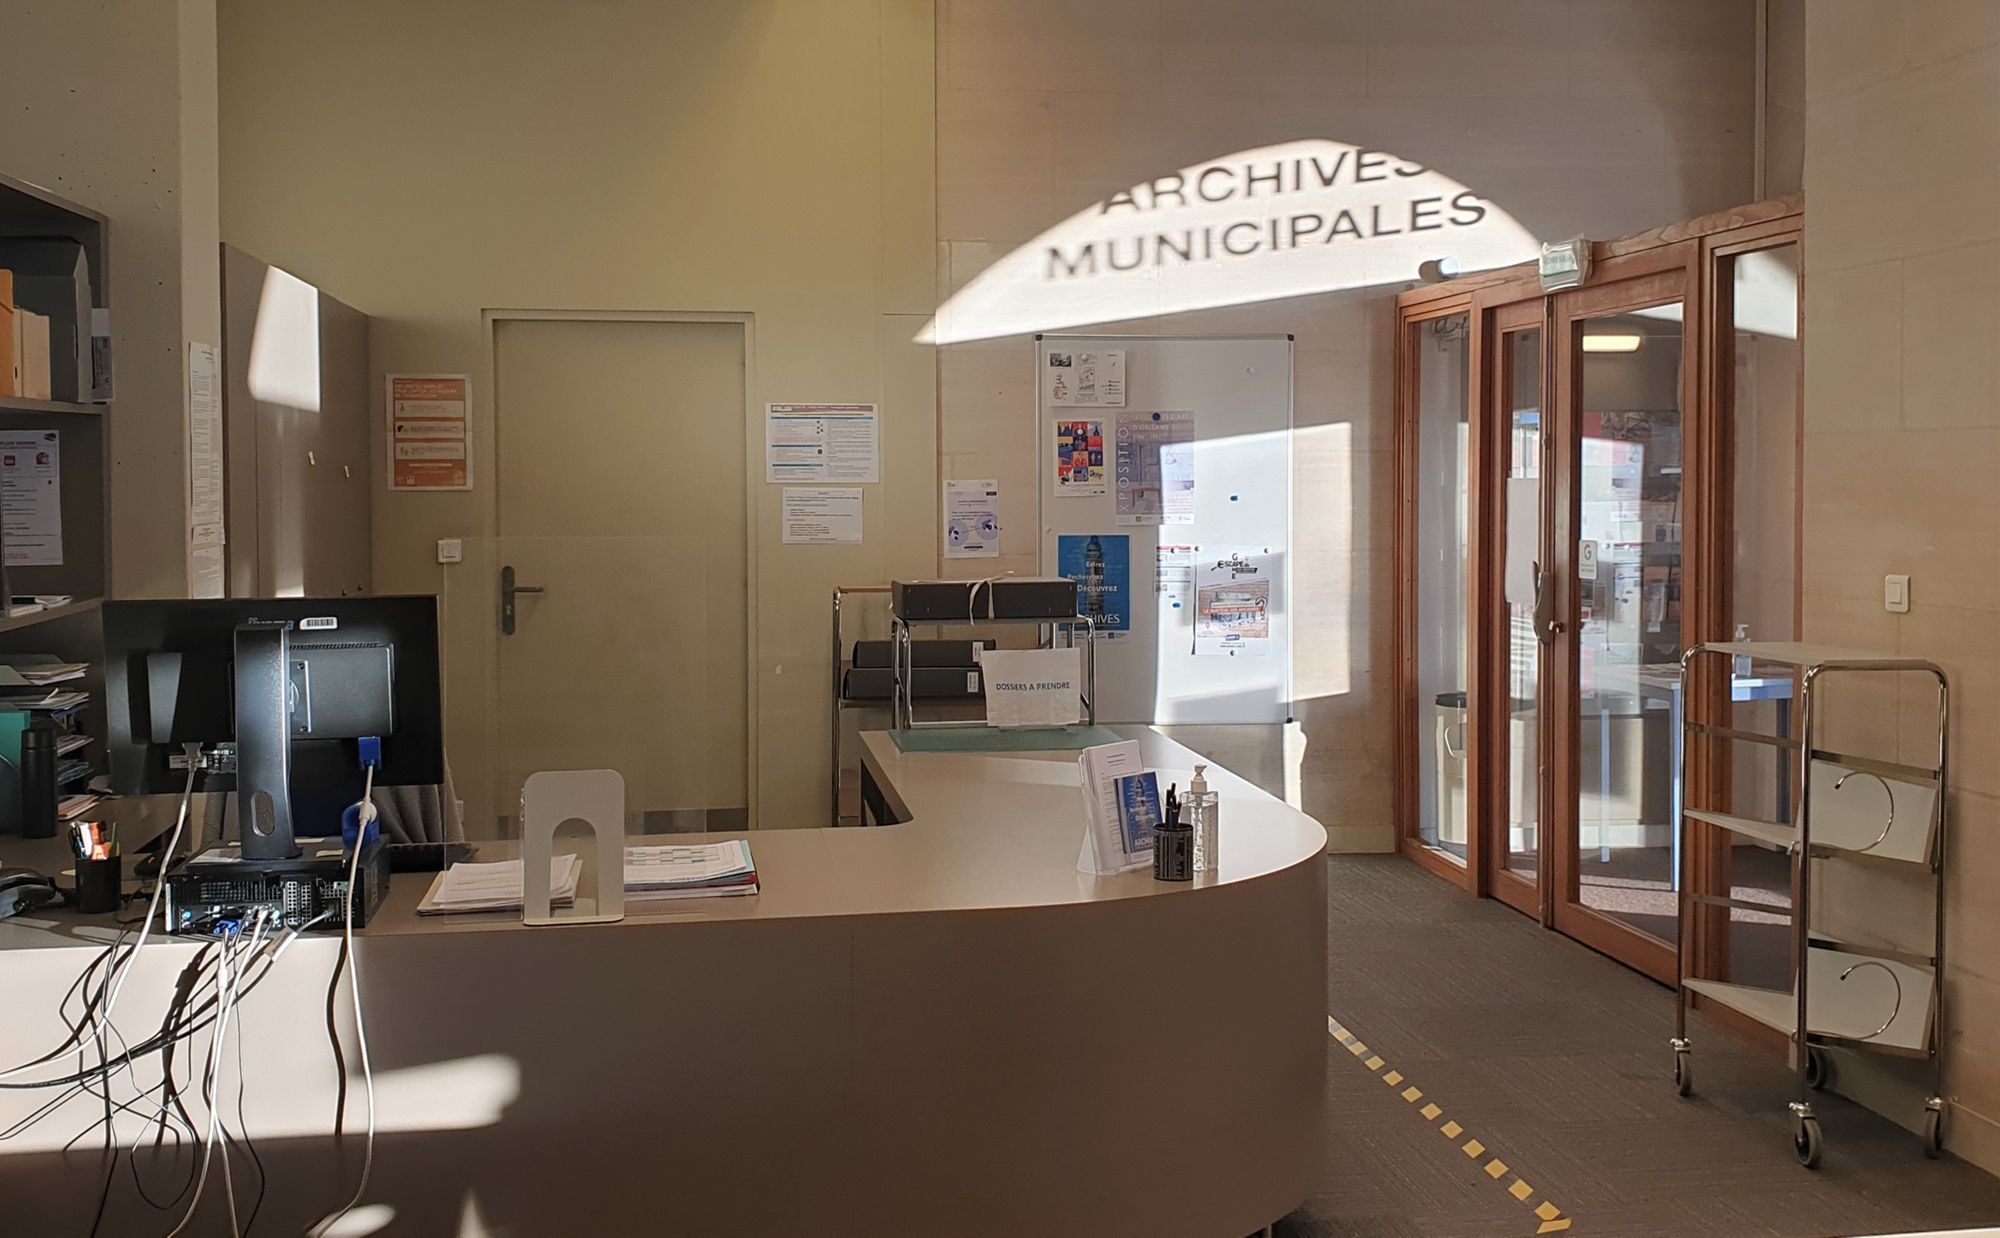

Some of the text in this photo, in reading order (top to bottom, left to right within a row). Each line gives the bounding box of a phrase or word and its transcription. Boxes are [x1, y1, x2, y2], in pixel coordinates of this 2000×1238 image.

[1045, 190, 1487, 280] MUNICIPALES
[1584, 544, 1592, 560] G
[1217, 560, 1244, 569] ESCAPE
[996, 682, 1027, 691] DOSSIERS
[1037, 681, 1070, 690] PRENDRE
